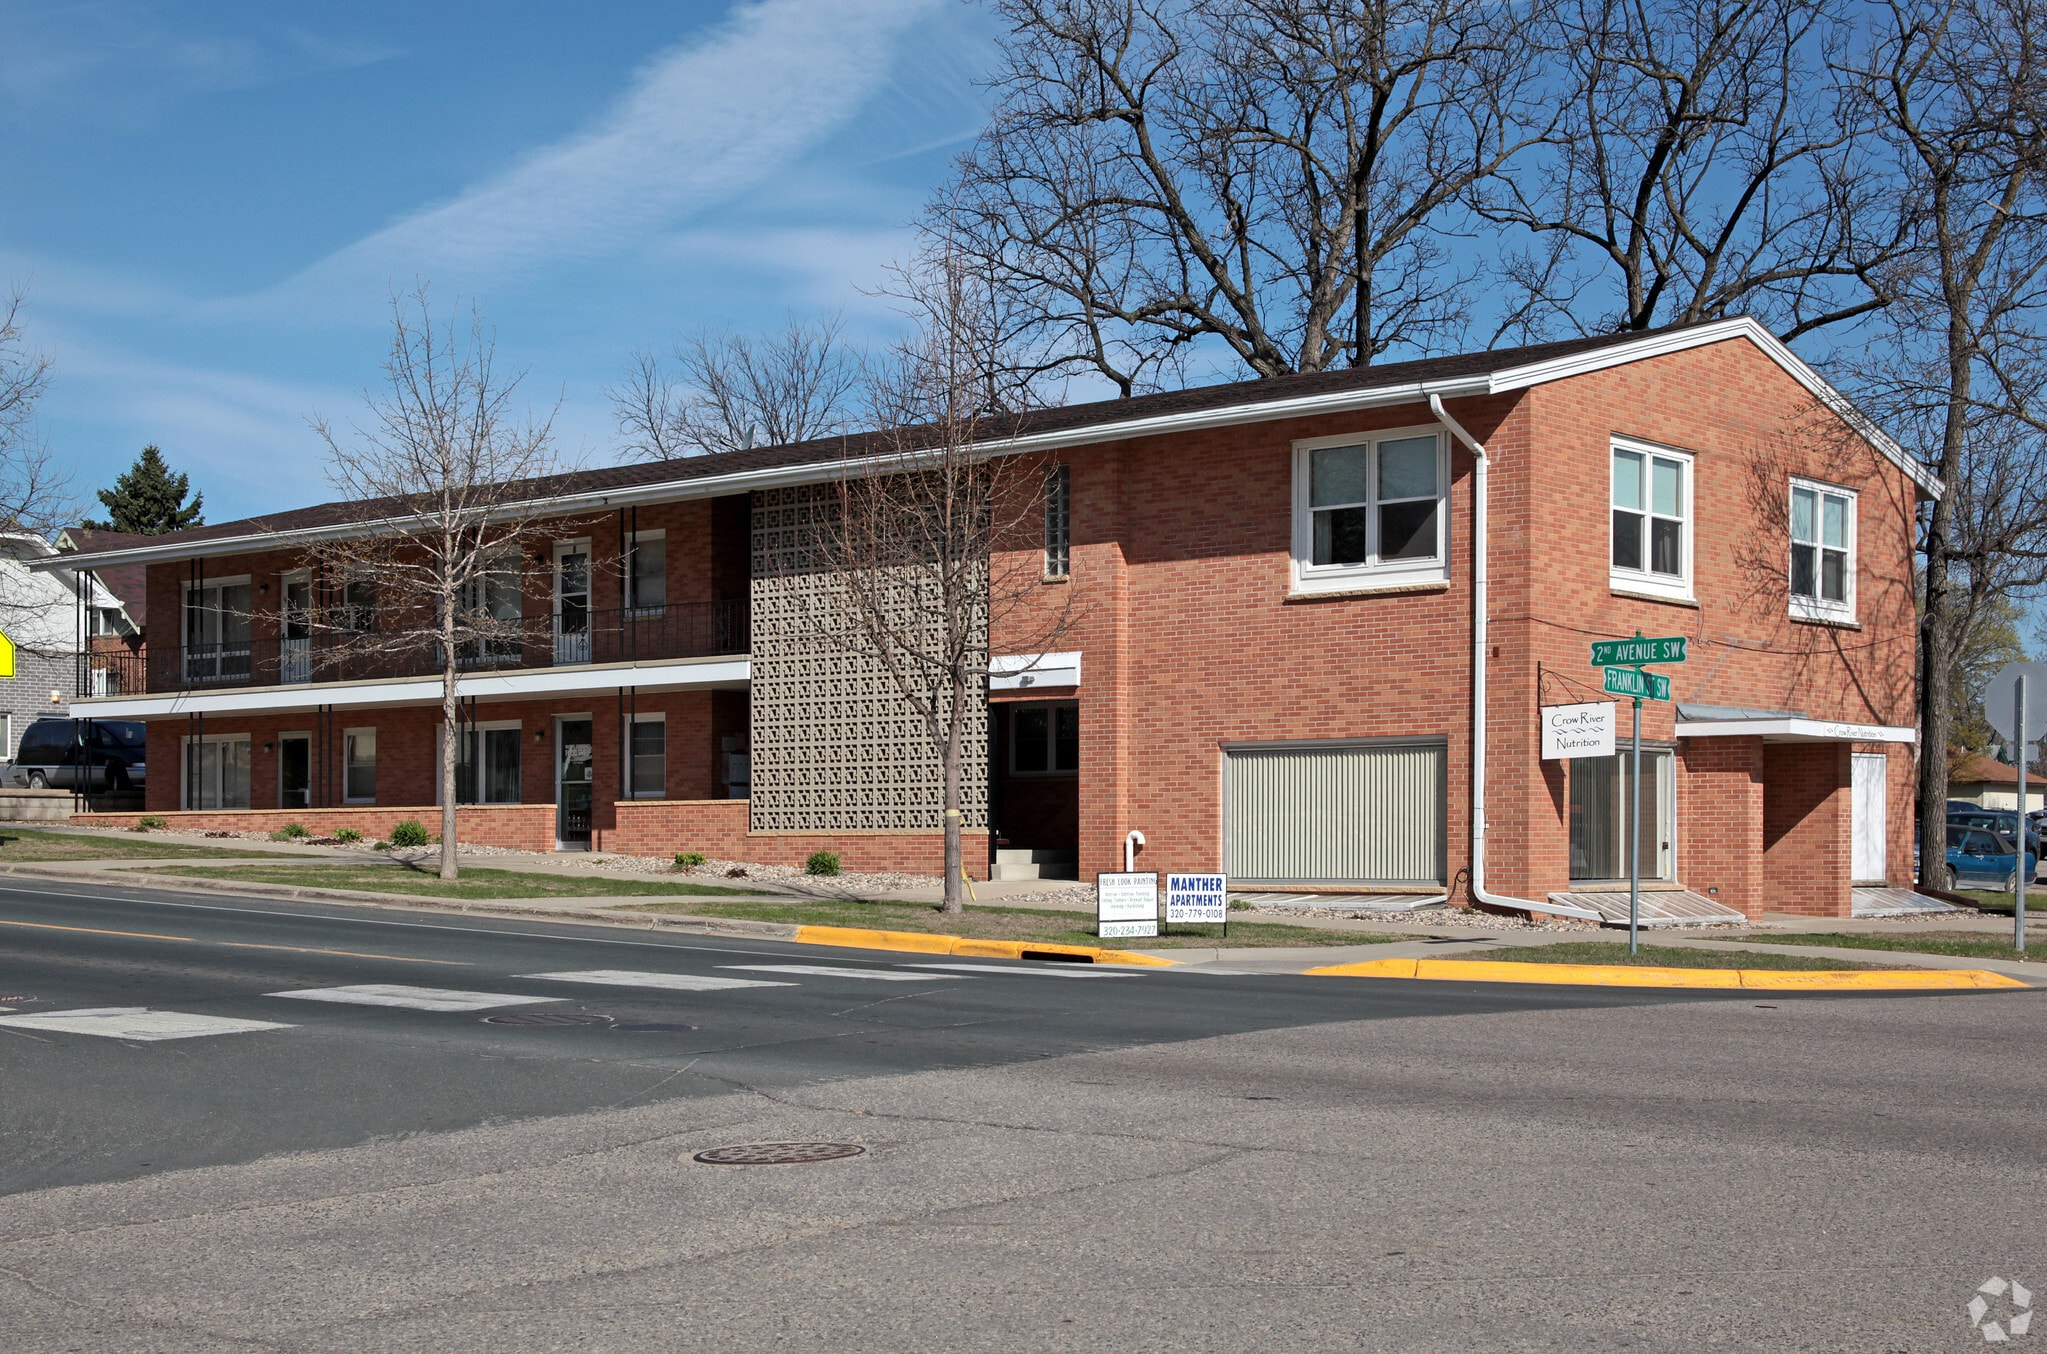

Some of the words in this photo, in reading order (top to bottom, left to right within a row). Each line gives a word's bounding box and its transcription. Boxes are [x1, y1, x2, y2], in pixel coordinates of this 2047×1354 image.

[1616, 643, 1657, 661] AVENUE
[1663, 641, 1680, 658] SW
[1607, 670, 1644, 694] FRANKLIN
[1646, 677, 1655, 695] ST
[1656, 678, 1667, 697] SW
[1551, 713, 1578, 727] Crow
[1580, 711, 1605, 724] River
[1834, 725, 1846, 737] Crow
[1858, 727, 1876, 738] Nutrition
[1556, 737, 1600, 750] Nutrition
[1100, 877, 1115, 886] FRESH
[1117, 877, 1131, 886] LOOK
[1171, 877, 1222, 891] MANTHER
[1170, 894, 1222, 907] APARTMENTS
[1170, 909, 1222, 918] 320-779-0108
